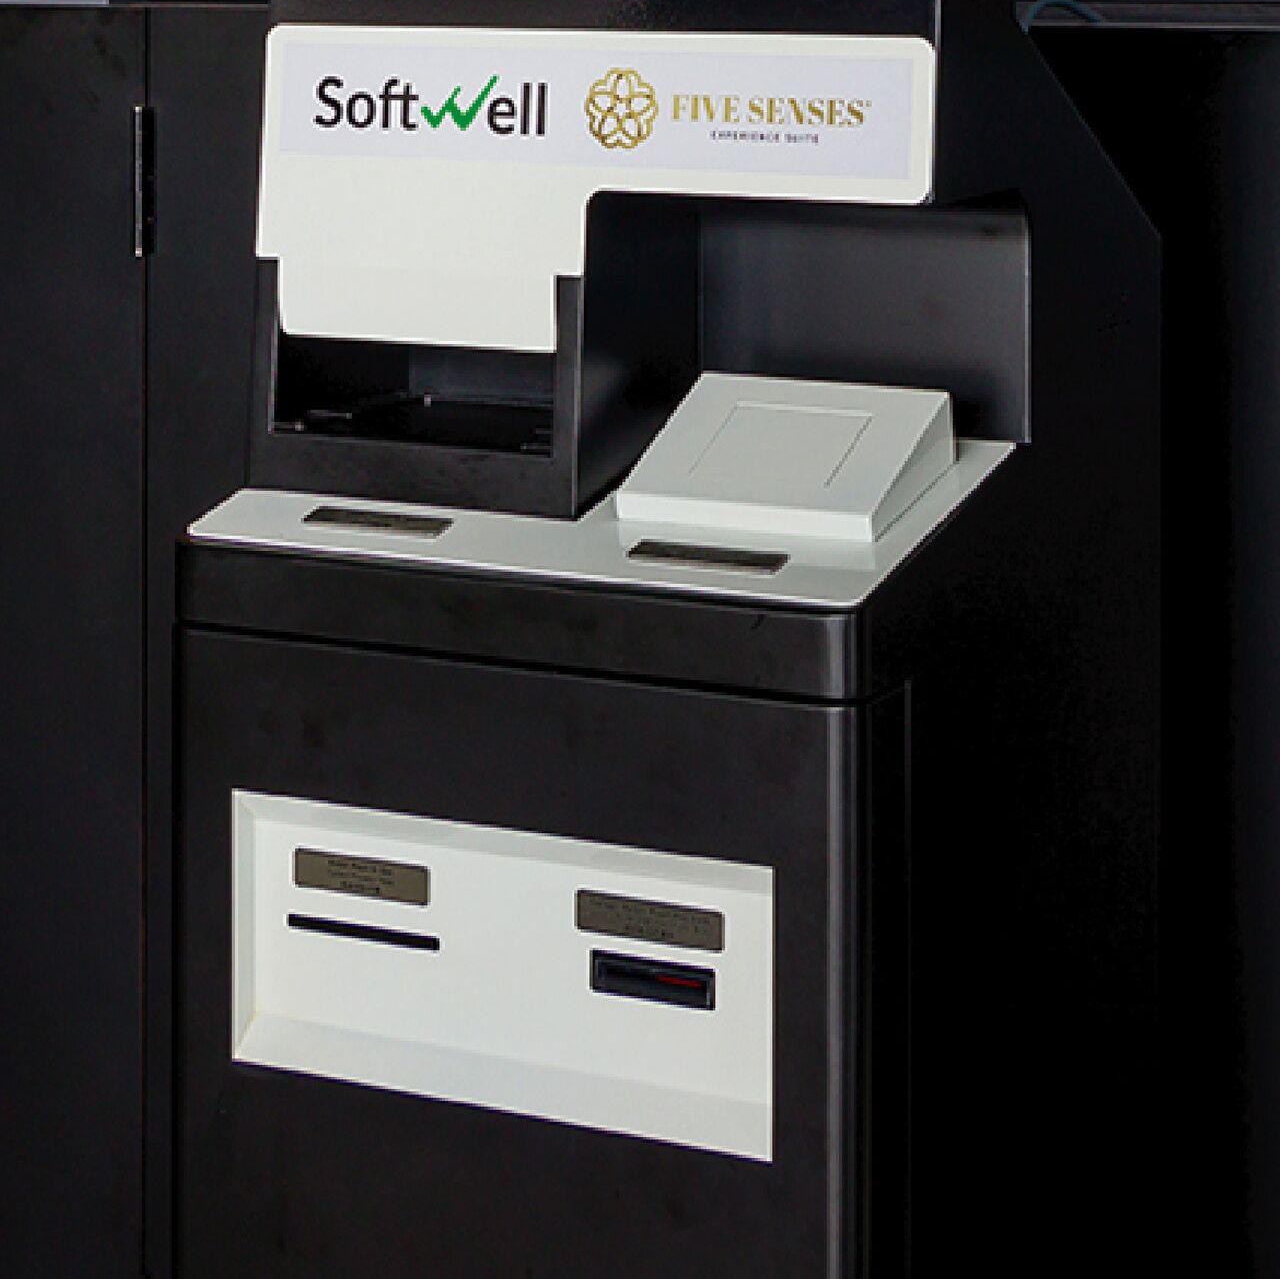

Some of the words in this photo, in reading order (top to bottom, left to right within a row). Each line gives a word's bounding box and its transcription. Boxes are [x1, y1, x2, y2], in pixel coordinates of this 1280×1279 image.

[313, 73, 548, 136] SoftWell
[673, 94, 740, 123] FIVE
[747, 96, 865, 127] SENSES
